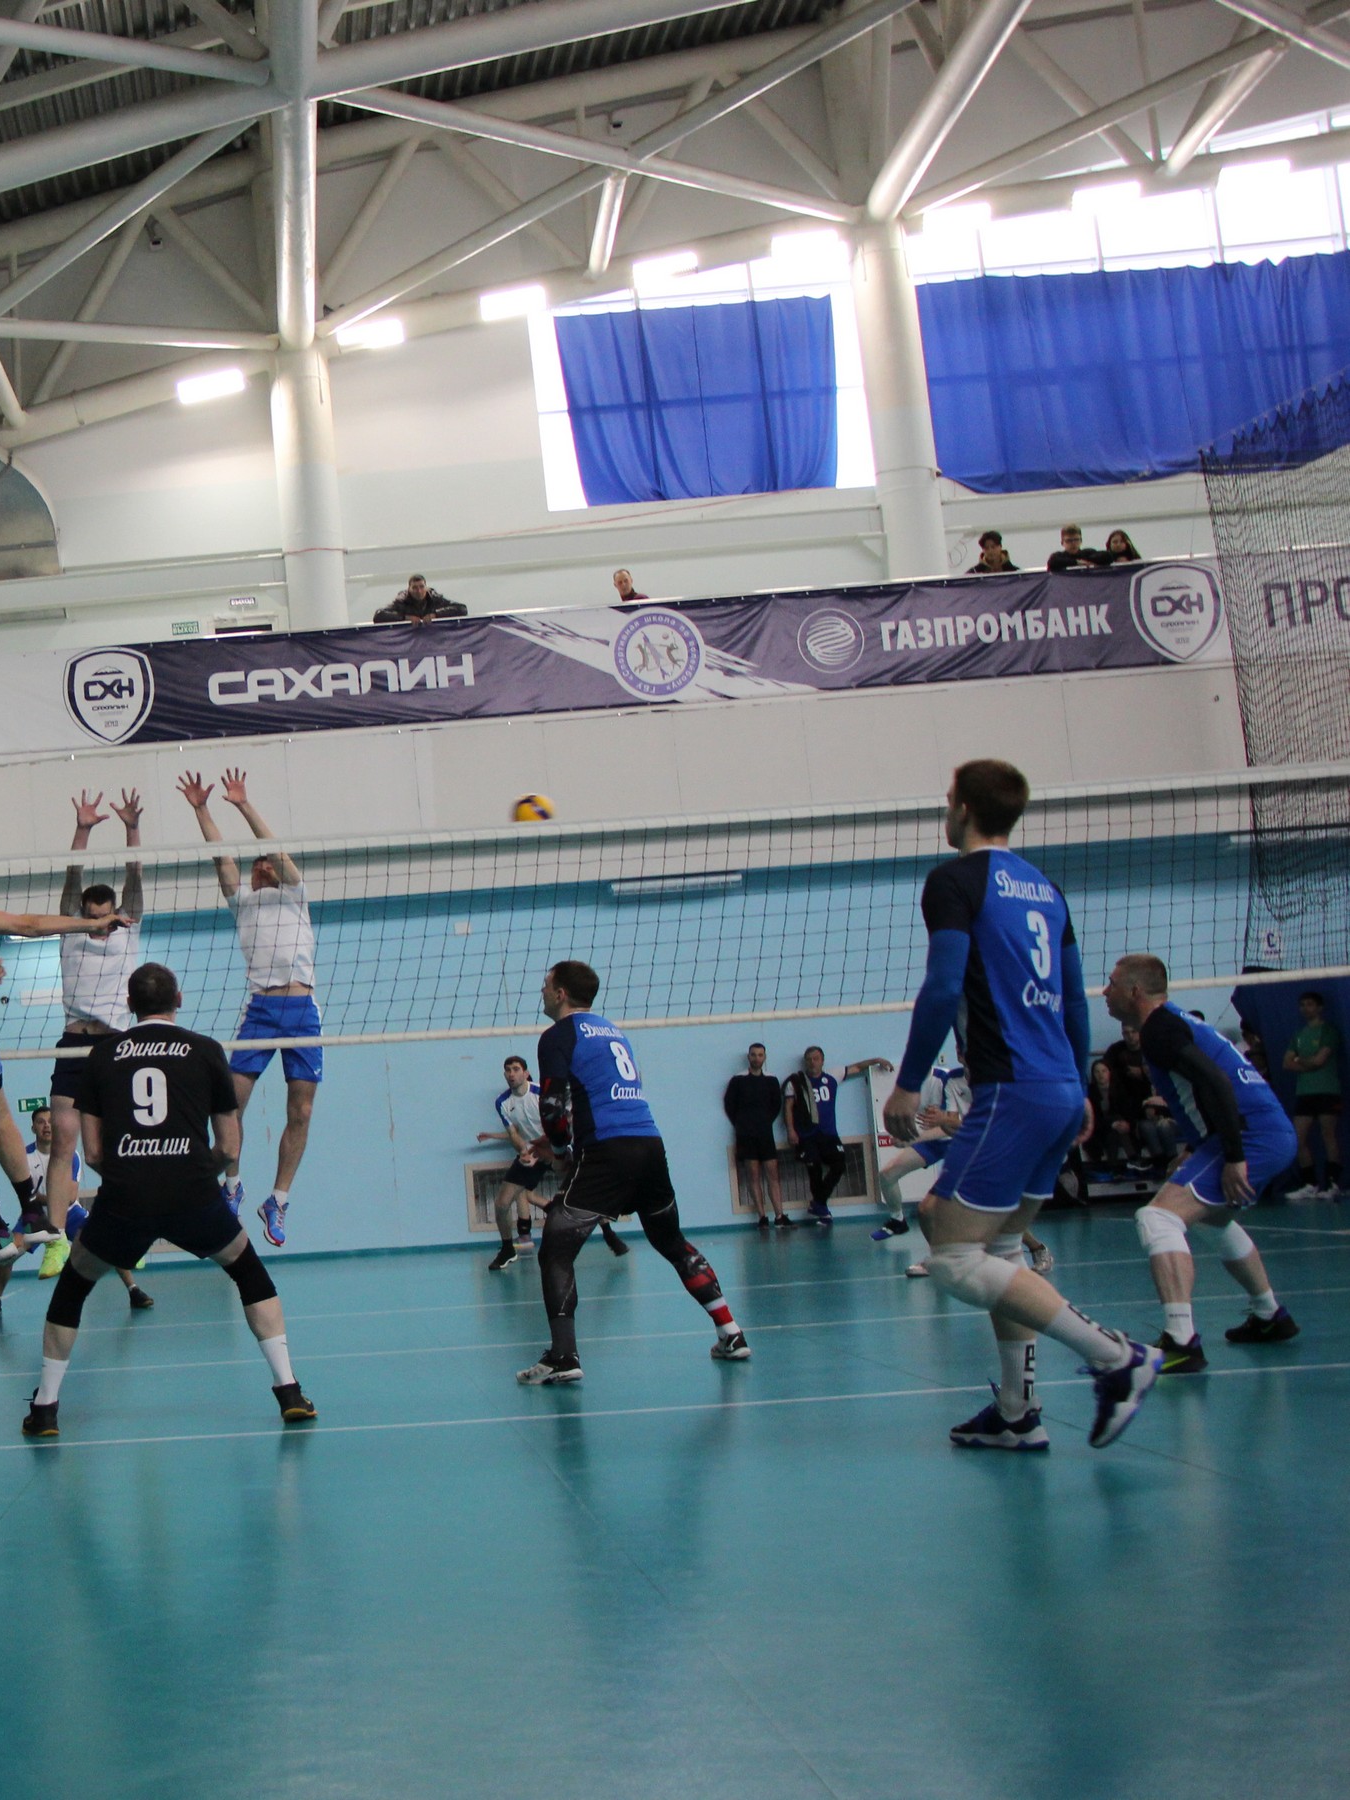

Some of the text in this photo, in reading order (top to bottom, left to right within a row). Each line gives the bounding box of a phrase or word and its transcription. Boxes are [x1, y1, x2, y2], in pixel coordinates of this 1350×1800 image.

[880, 604, 1113, 651] ГАЗПРОМБАНК
[208, 653, 475, 705] САХАЛИН
[995, 869, 1054, 904] Динамо
[1026, 910, 1051, 979] 3
[114, 1038, 192, 1061] Динамо
[609, 1041, 637, 1081] 8
[132, 1067, 168, 1126] 9
[117, 1133, 190, 1158] Сахалин
